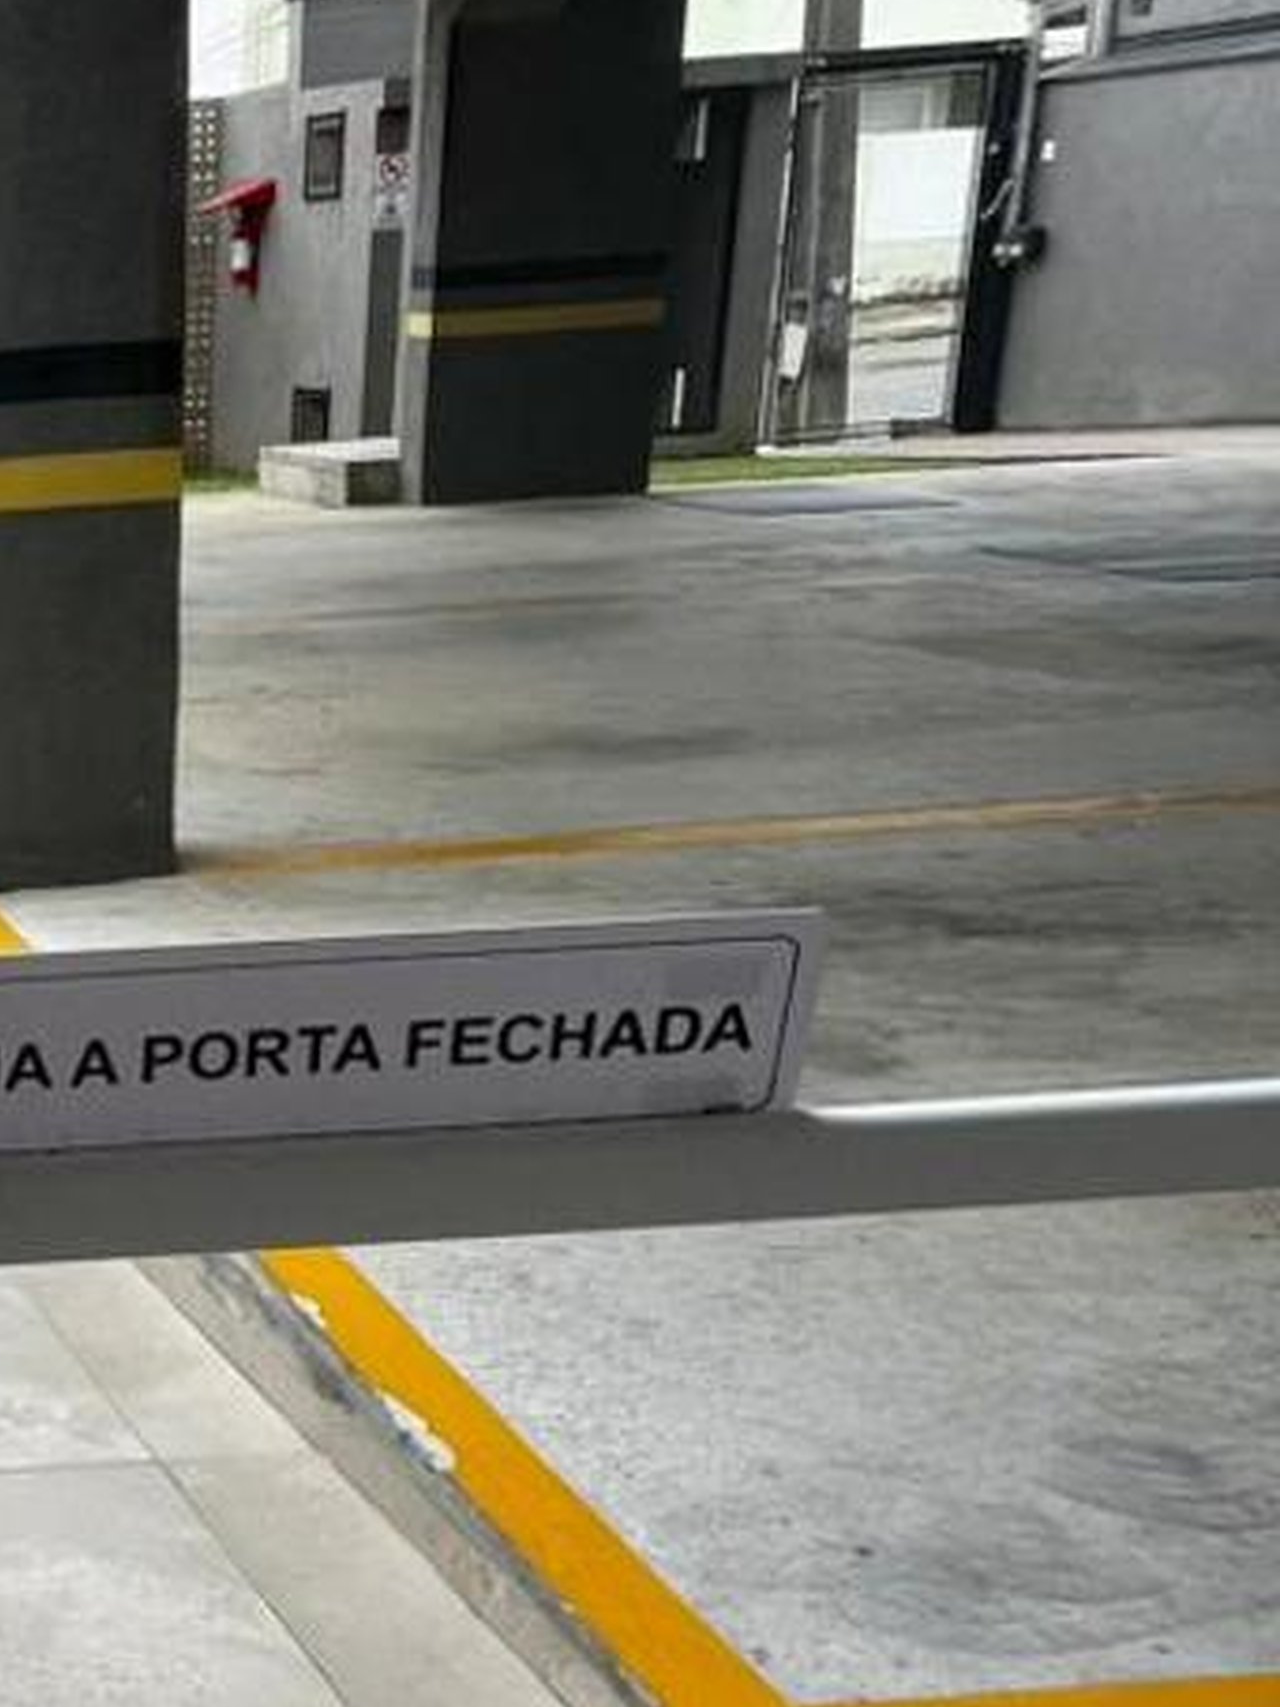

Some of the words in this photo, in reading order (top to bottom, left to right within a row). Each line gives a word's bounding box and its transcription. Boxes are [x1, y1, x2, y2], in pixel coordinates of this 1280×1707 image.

[70, 1038, 119, 1089] A
[141, 1023, 381, 1084] PORTA
[404, 1002, 753, 1069] FECHADA
